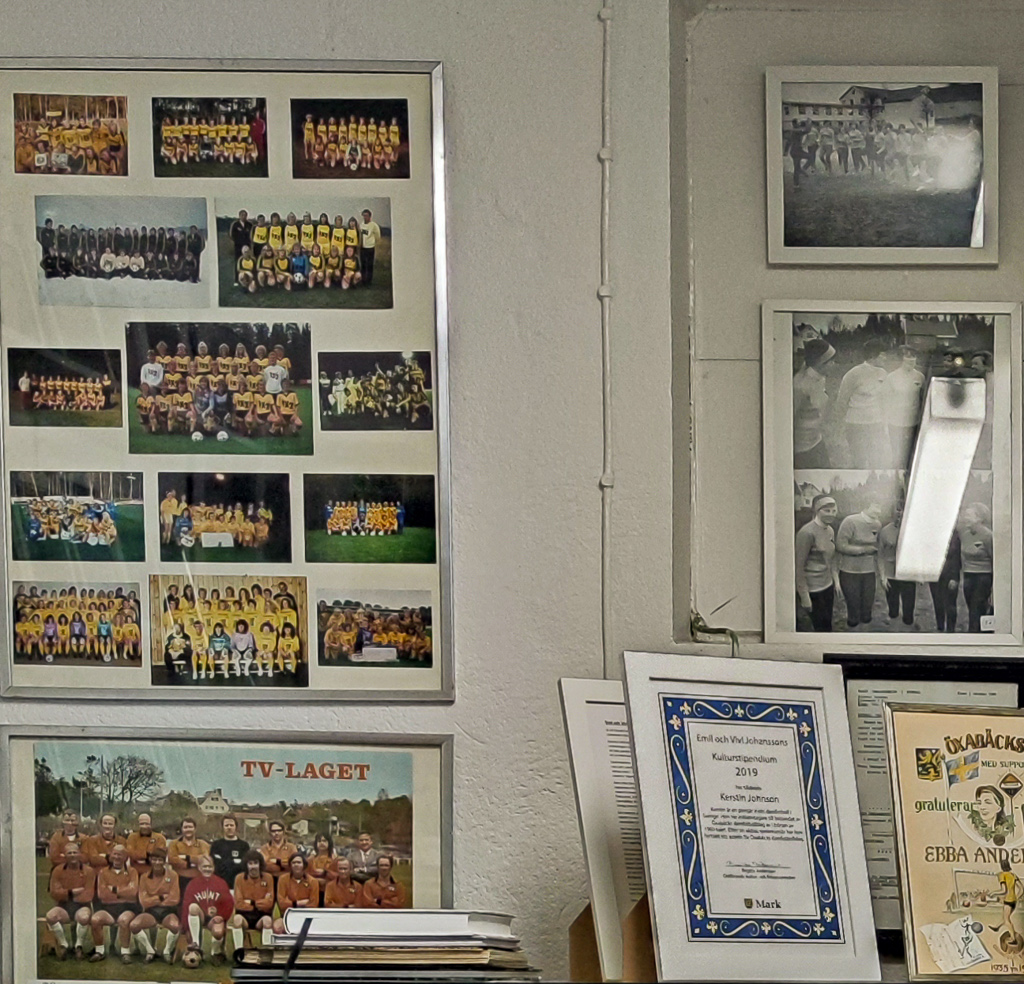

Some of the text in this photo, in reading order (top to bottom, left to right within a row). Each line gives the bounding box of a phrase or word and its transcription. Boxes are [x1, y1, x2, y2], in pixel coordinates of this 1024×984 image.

[697, 734, 713, 742] Emil
[745, 737, 788, 746] Johanssons
[944, 729, 1024, 755] ÖXABÄCKS
[712, 753, 777, 763] Kulturstipendium
[241, 760, 371, 781] TV-LAGET
[735, 767, 758, 776] 2019
[720, 793, 780, 803] Kerstin Johnson
[925, 846, 969, 863] EBBA
[194, 891, 221, 902] HUNT
[756, 899, 781, 909] Mark
